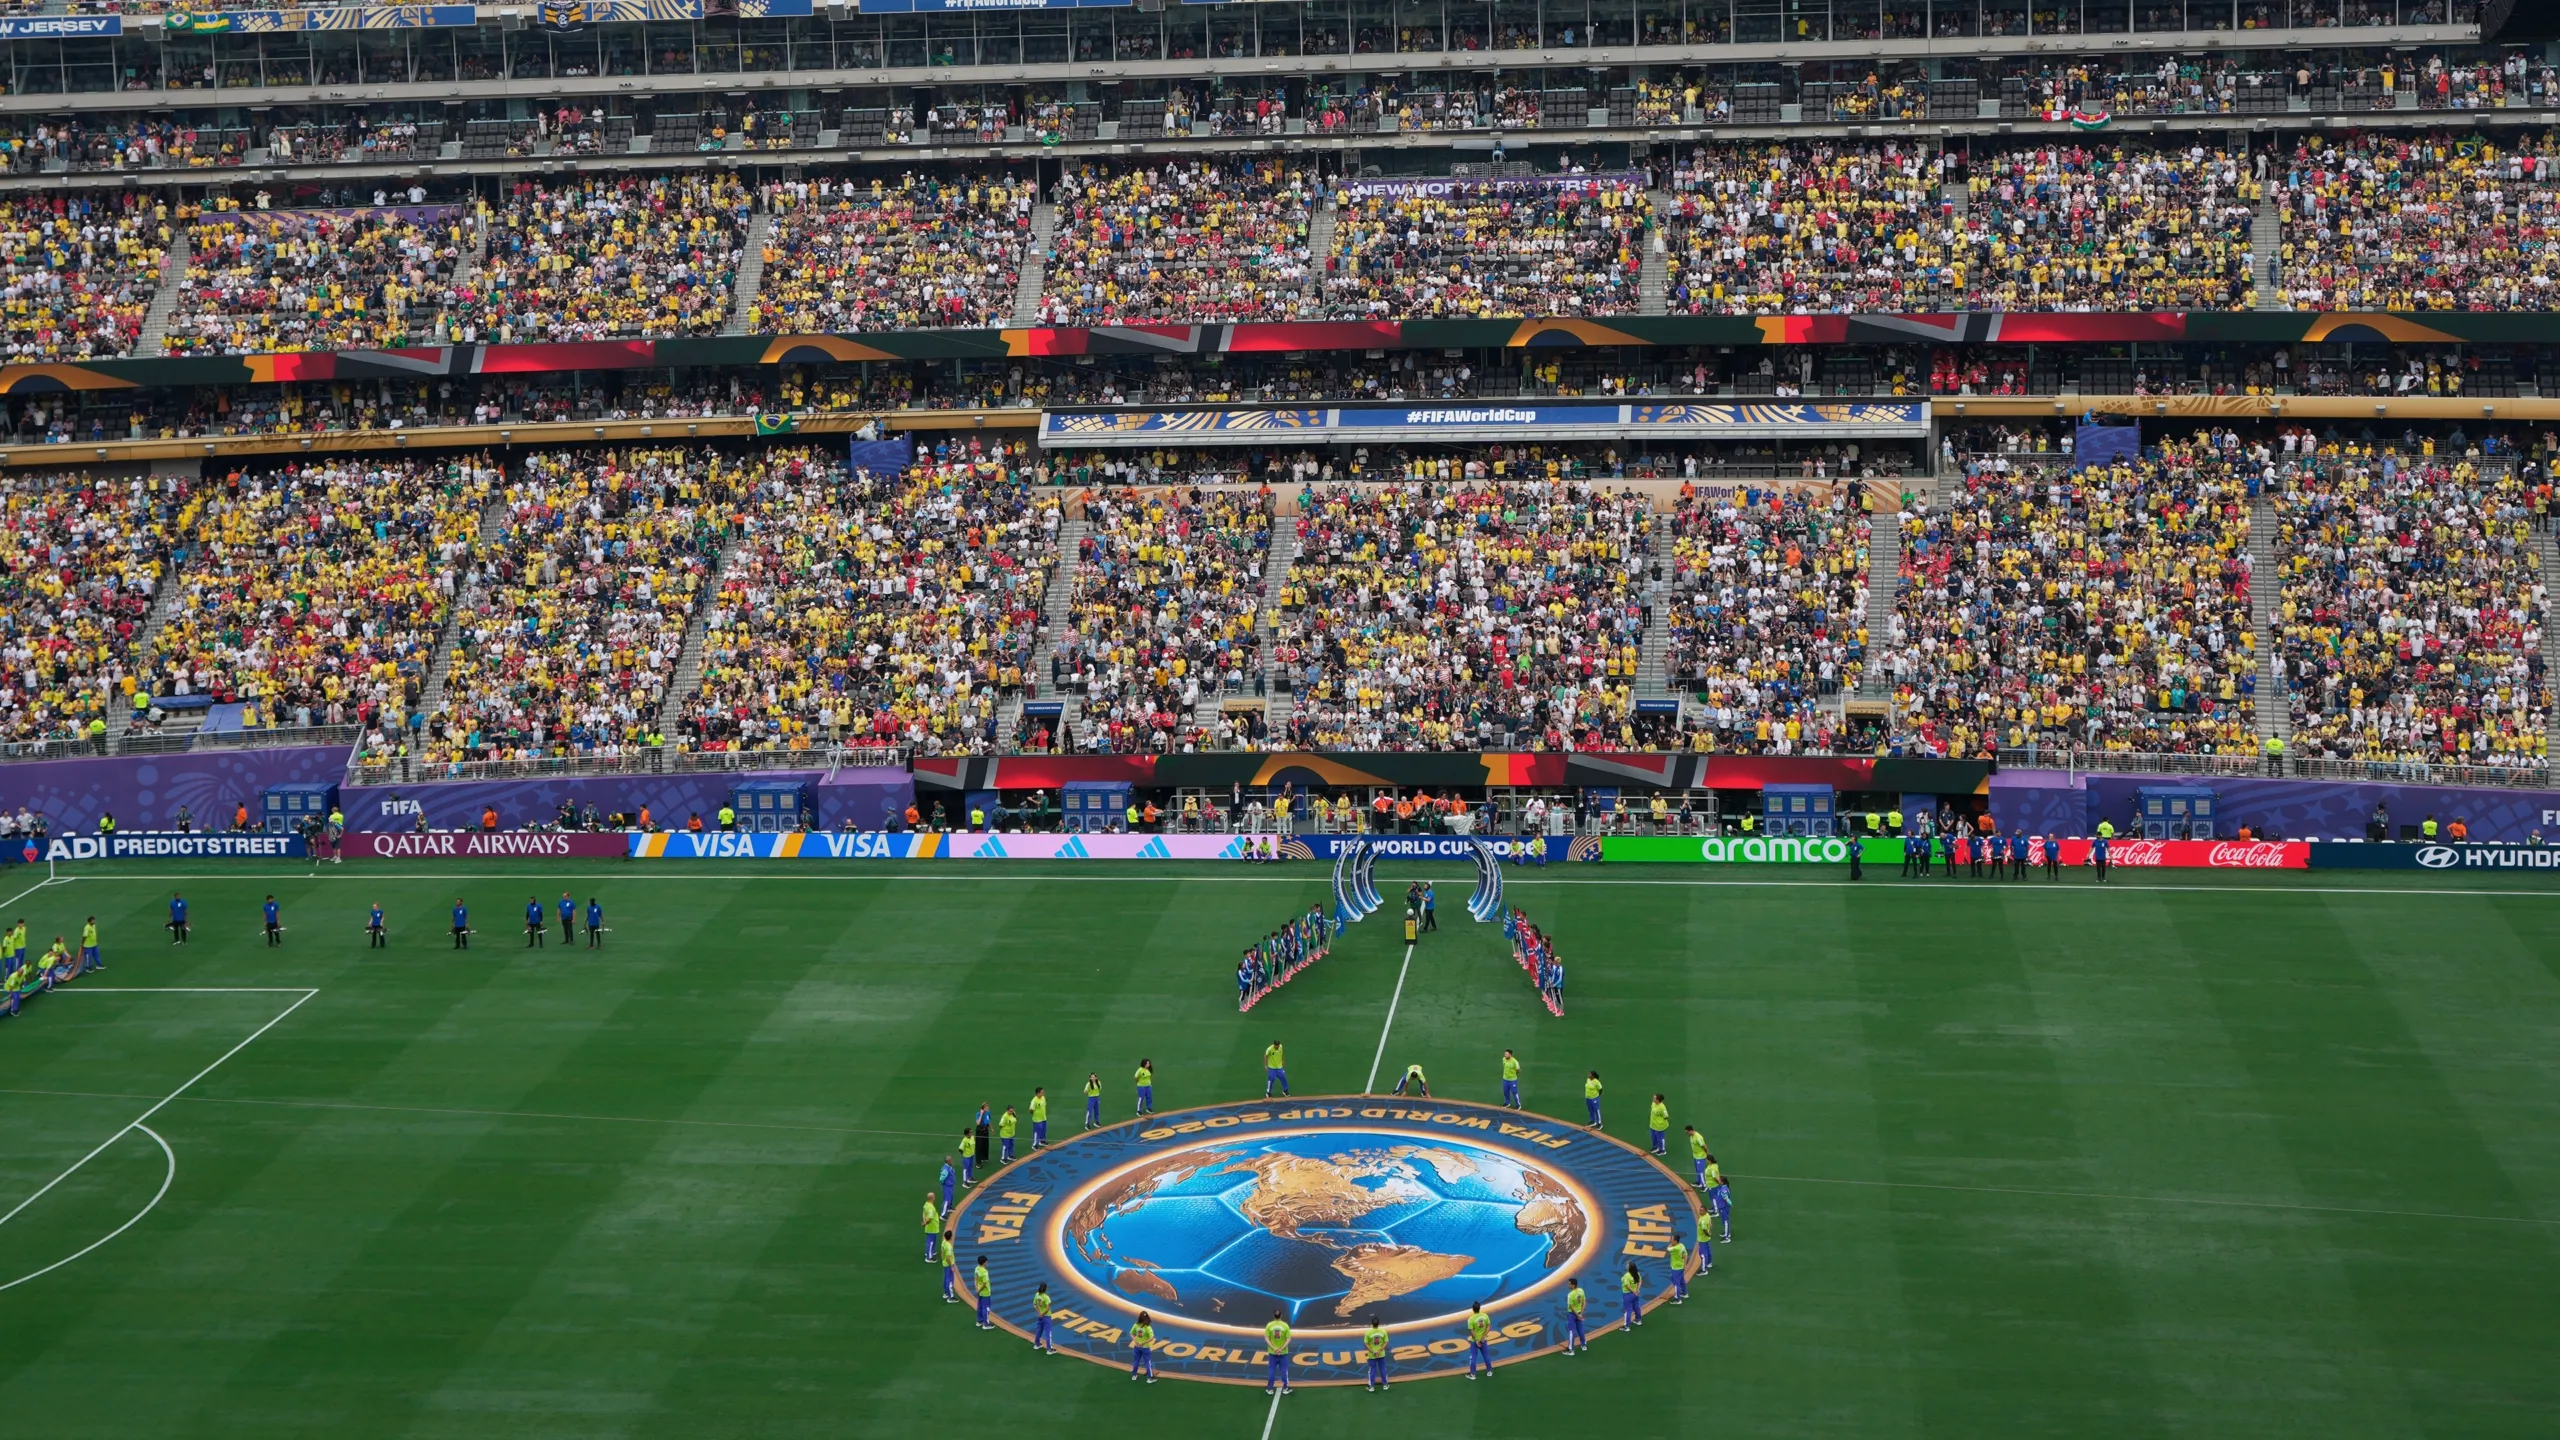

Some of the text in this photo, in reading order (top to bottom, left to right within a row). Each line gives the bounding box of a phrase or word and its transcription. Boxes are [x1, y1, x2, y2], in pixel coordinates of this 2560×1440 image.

[20, 20, 108, 33] JERSEY
[1407, 409, 1536, 423] #FIFAWorldCup
[381, 800, 422, 815] FIFA
[45, 837, 290, 861] ADI PREDICTSTREET
[373, 835, 570, 857] QATAR AIRWAYS
[685, 833, 755, 857] VISA
[821, 833, 891, 857] VISA
[1371, 840, 1430, 855] WORLD
[1701, 838, 1847, 862] aramco
[2208, 841, 2288, 866] Coca-Cola
[1140, 1107, 1571, 1149] FIFA WORLD CUP 2026
[978, 1191, 1043, 1244] FIFA
[1622, 1204, 1671, 1258] FIFA
[1050, 1308, 1123, 1344] FIFA
